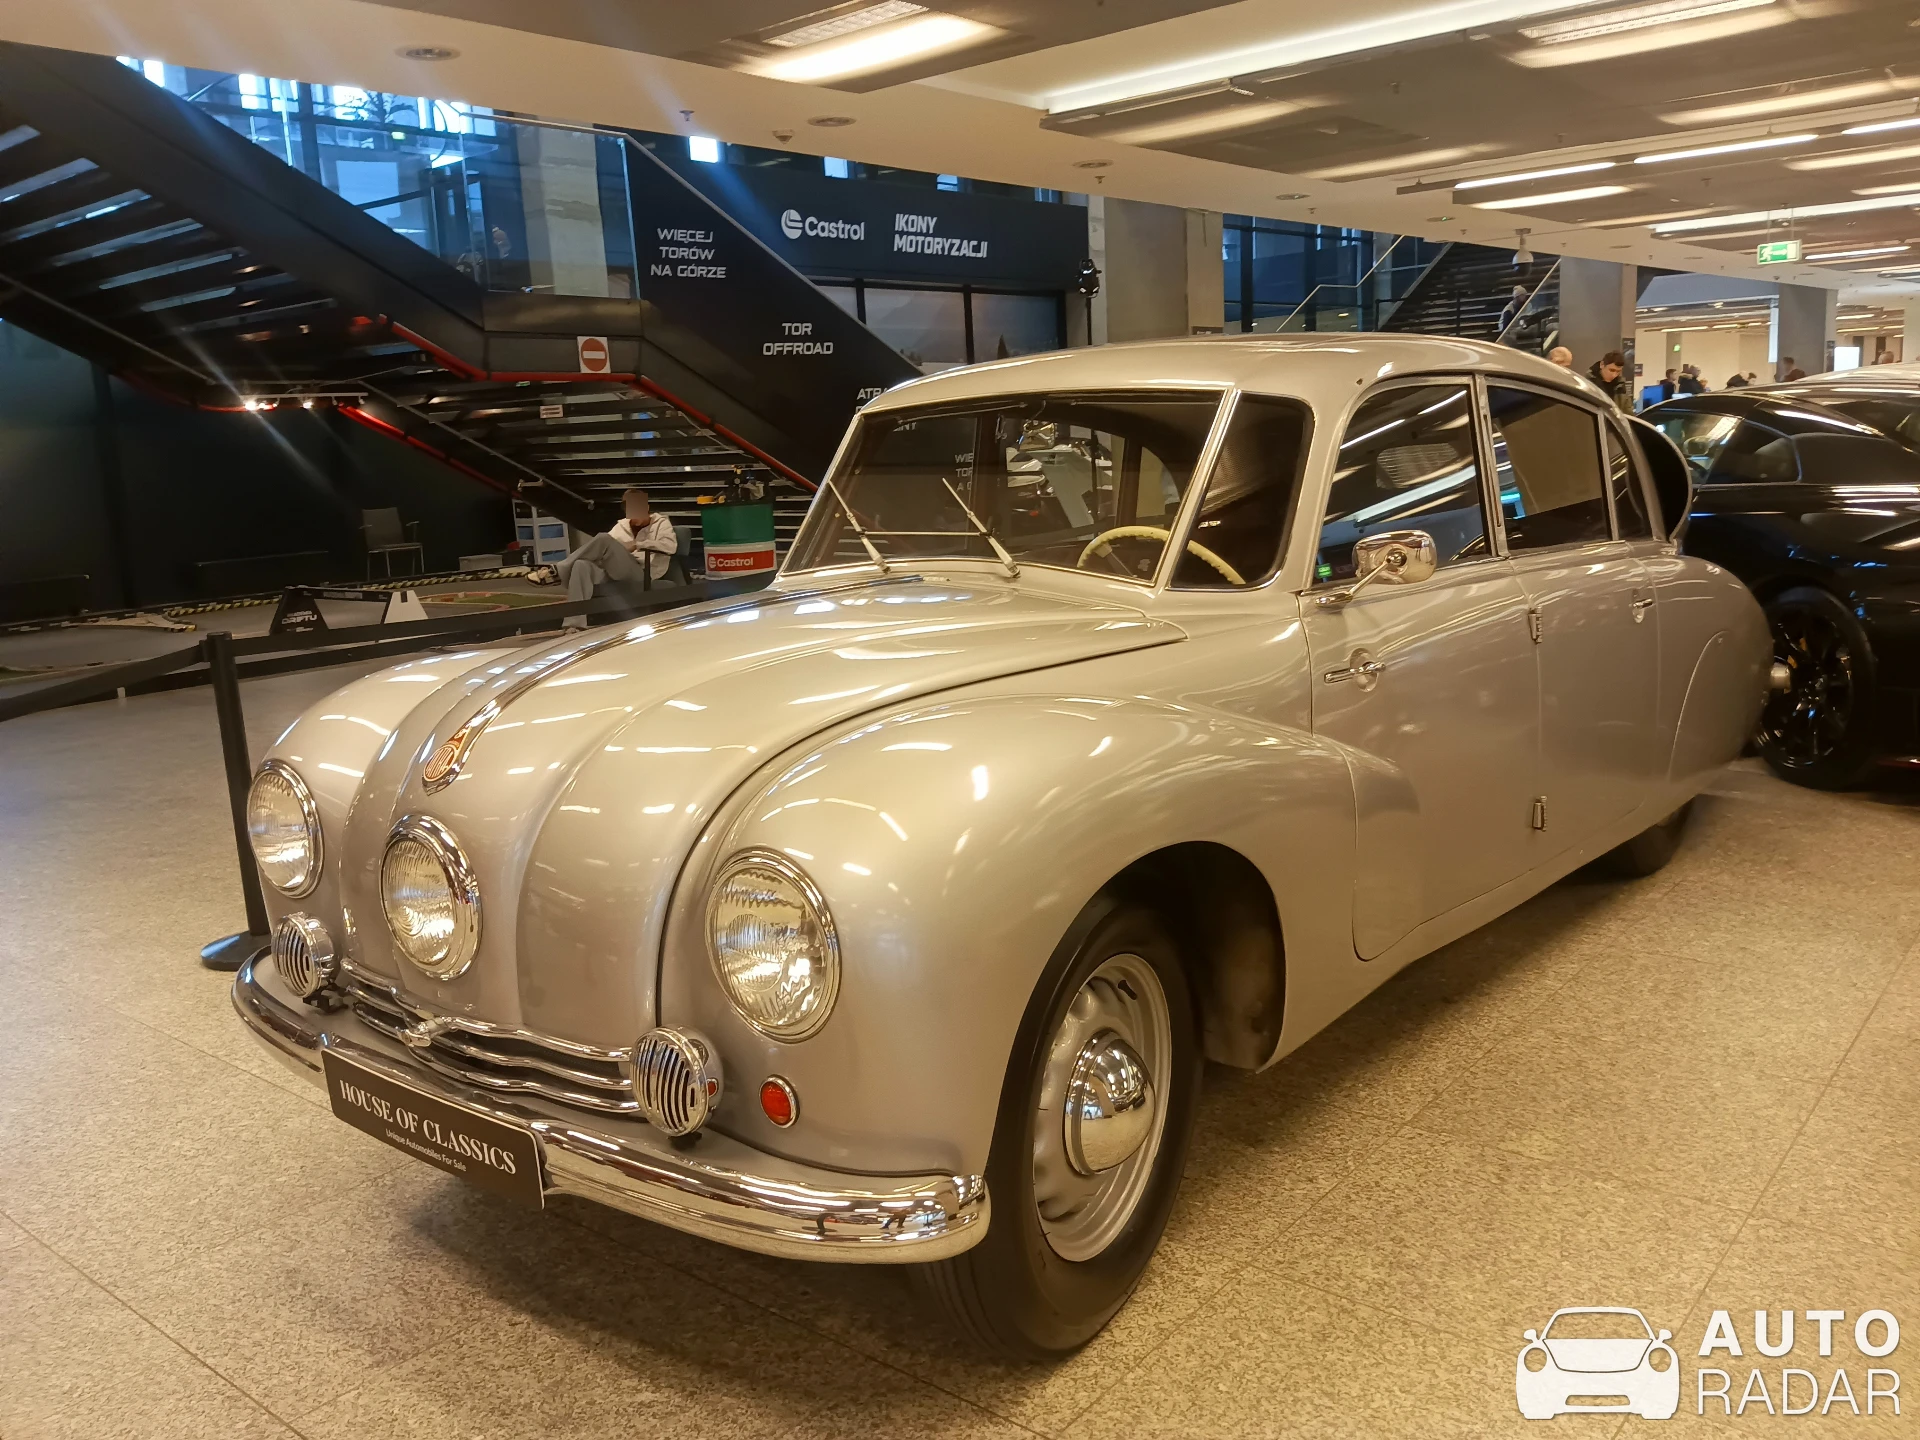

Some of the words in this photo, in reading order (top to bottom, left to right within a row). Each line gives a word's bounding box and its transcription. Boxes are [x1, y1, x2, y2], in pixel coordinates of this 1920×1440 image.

[805, 216, 865, 241] Castrol
[895, 213, 938, 234] IKONY
[656, 227, 714, 244] WIĘCEJ
[659, 246, 715, 260] TORÓW
[893, 234, 988, 259] MOTORYZACJI
[650, 263, 673, 277] NA
[677, 263, 727, 278] GÓRZE
[781, 322, 813, 336] TOR
[762, 341, 834, 356] OFFROAD
[717, 557, 754, 568] Castrol
[339, 1079, 394, 1123] HOUSE
[396, 1107, 419, 1134] OF
[423, 1119, 516, 1175] CLASSICS
[385, 1128, 406, 1145] Unique
[406, 1138, 442, 1161] Automobiles
[442, 1153, 453, 1166] For
[453, 1159, 467, 1172] Sale
